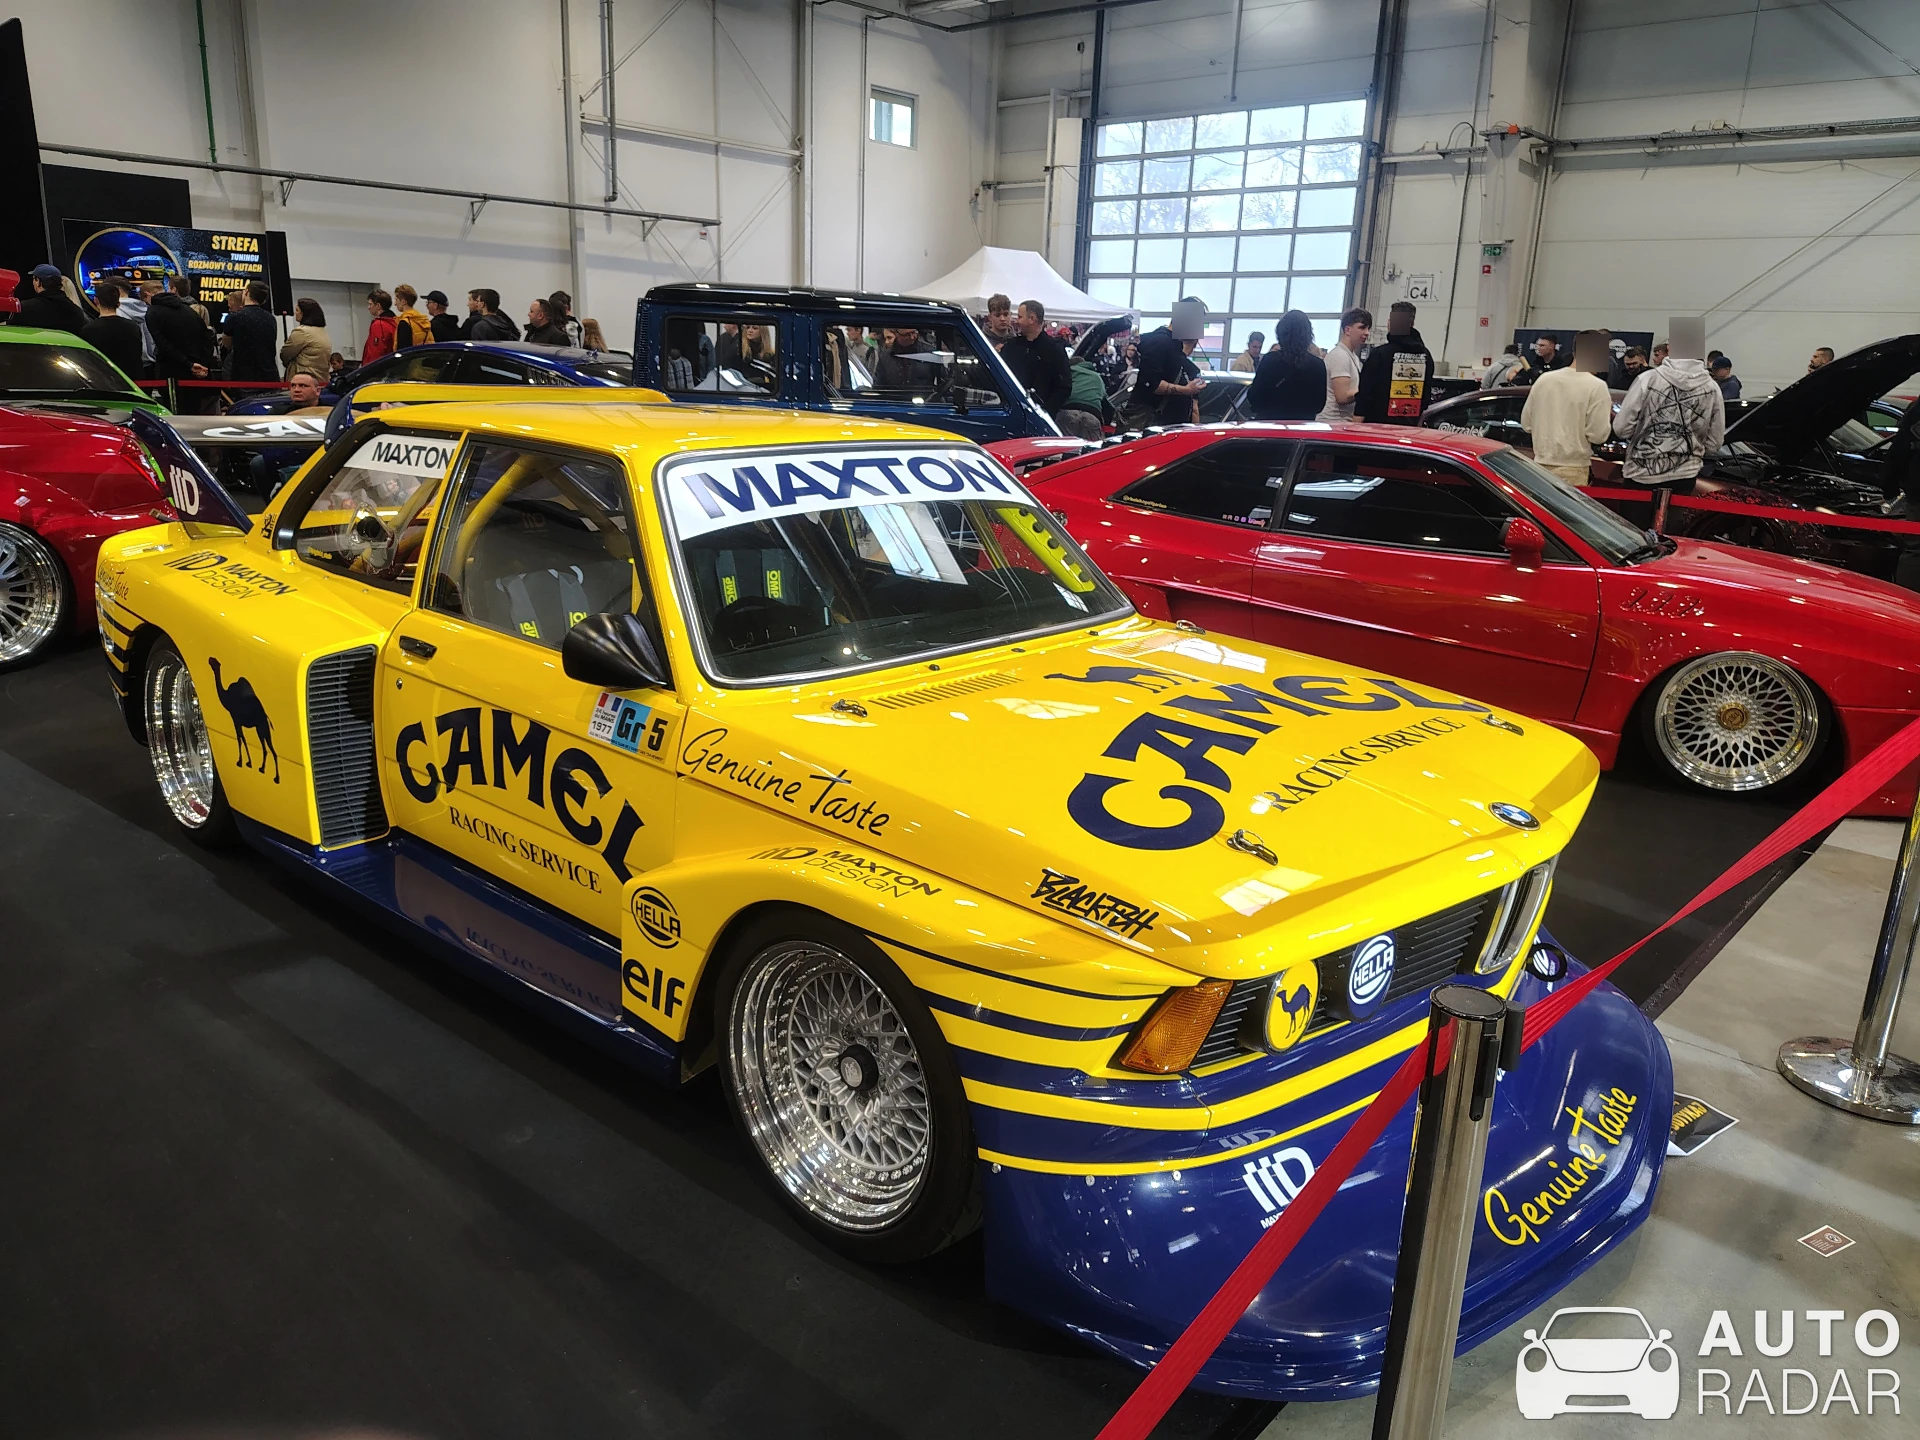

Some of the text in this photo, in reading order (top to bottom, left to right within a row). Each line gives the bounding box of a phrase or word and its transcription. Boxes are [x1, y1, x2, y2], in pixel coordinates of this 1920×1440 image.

[211, 235, 259, 253] STREFA
[230, 253, 259, 262] TUNINGU
[188, 260, 263, 273] ROZMOWY O AUTACH
[1410, 286, 1428, 300] C4
[371, 442, 456, 469] MAXTON
[681, 456, 1012, 519] MAXTON
[192, 569, 261, 600] DESIGN
[220, 563, 298, 596] MAXTON
[768, 570, 781, 598] OMP
[592, 720, 612, 735] 1977
[617, 707, 646, 743] Gr
[648, 717, 668, 752] 5
[682, 728, 802, 803] Genuine
[809, 769, 890, 836] Taste
[1067, 675, 1489, 851] CAMEL
[1264, 716, 1466, 813] RACING SERVICE
[396, 707, 645, 885] CAMEL
[450, 806, 602, 894] RACING SERVICE
[803, 857, 910, 898] DESIGN
[823, 850, 942, 896] MAXTON
[635, 900, 681, 938] HELLA
[1354, 945, 1394, 989] HELLA
[623, 959, 685, 1018] elf
[1484, 1087, 1637, 1245] Genuine Taste
